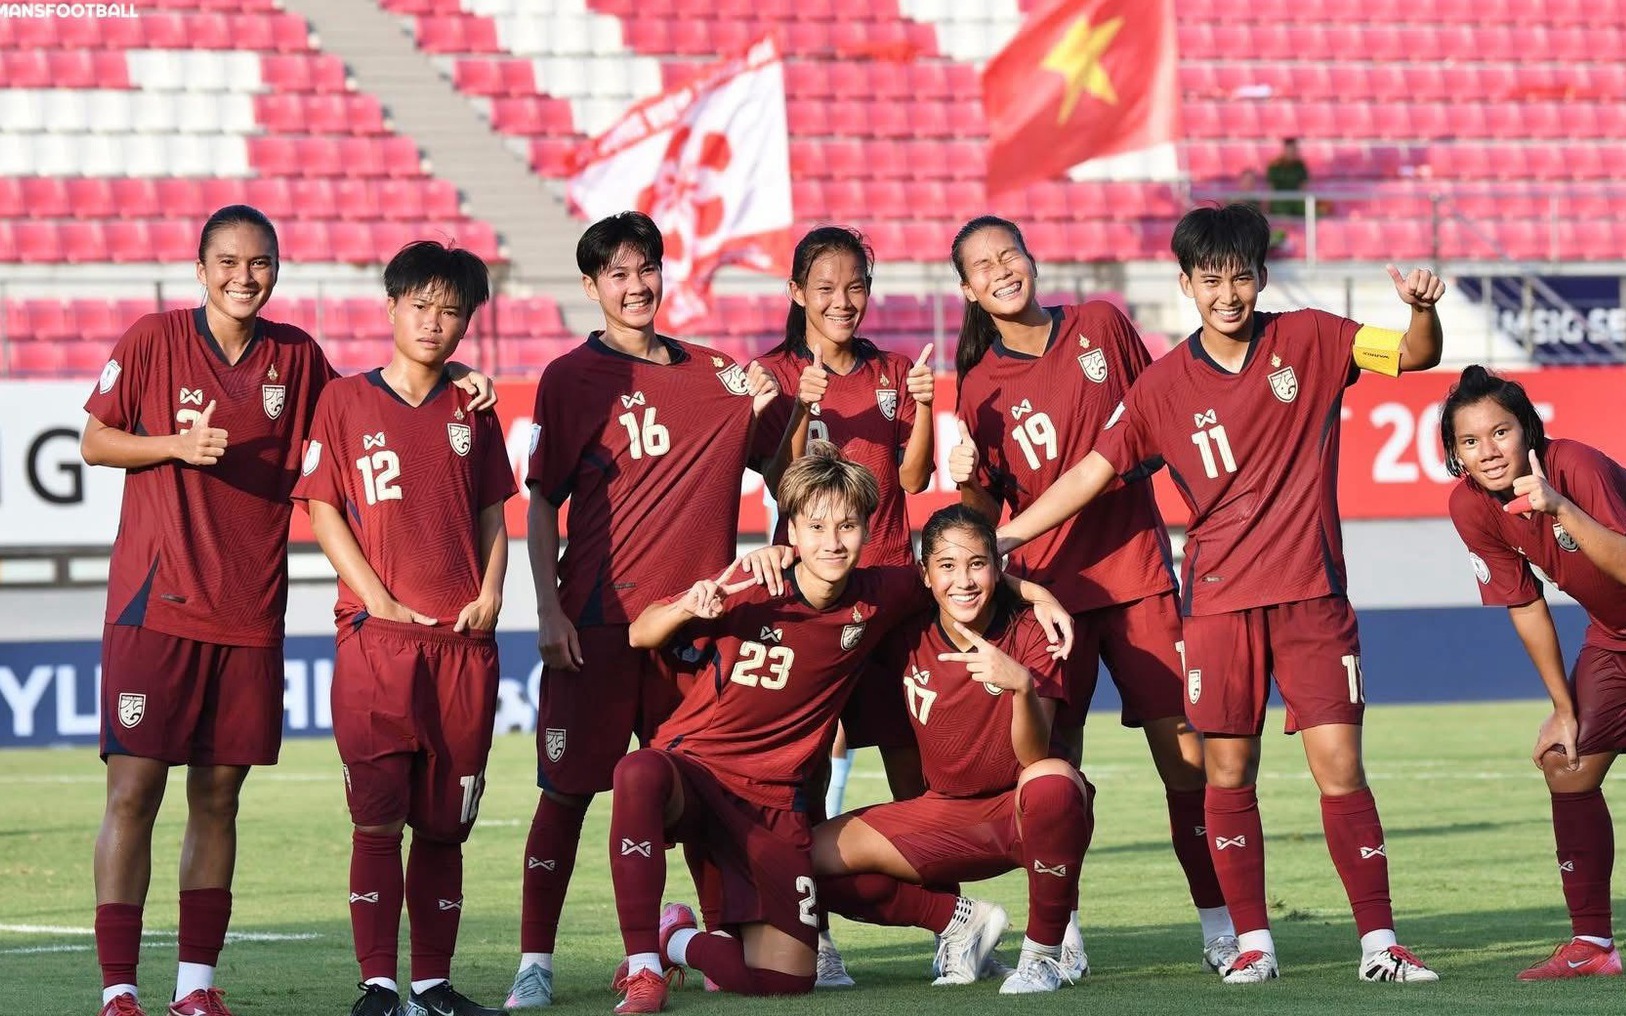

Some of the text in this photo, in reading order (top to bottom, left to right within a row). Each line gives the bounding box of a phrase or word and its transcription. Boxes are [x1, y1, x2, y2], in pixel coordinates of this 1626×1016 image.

[619, 406, 671, 460] 16
[1011, 412, 1058, 471] 19
[1191, 424, 1238, 479] 11
[356, 450, 403, 506] 12
[730, 640, 795, 690] 23
[903, 676, 937, 726] 17
